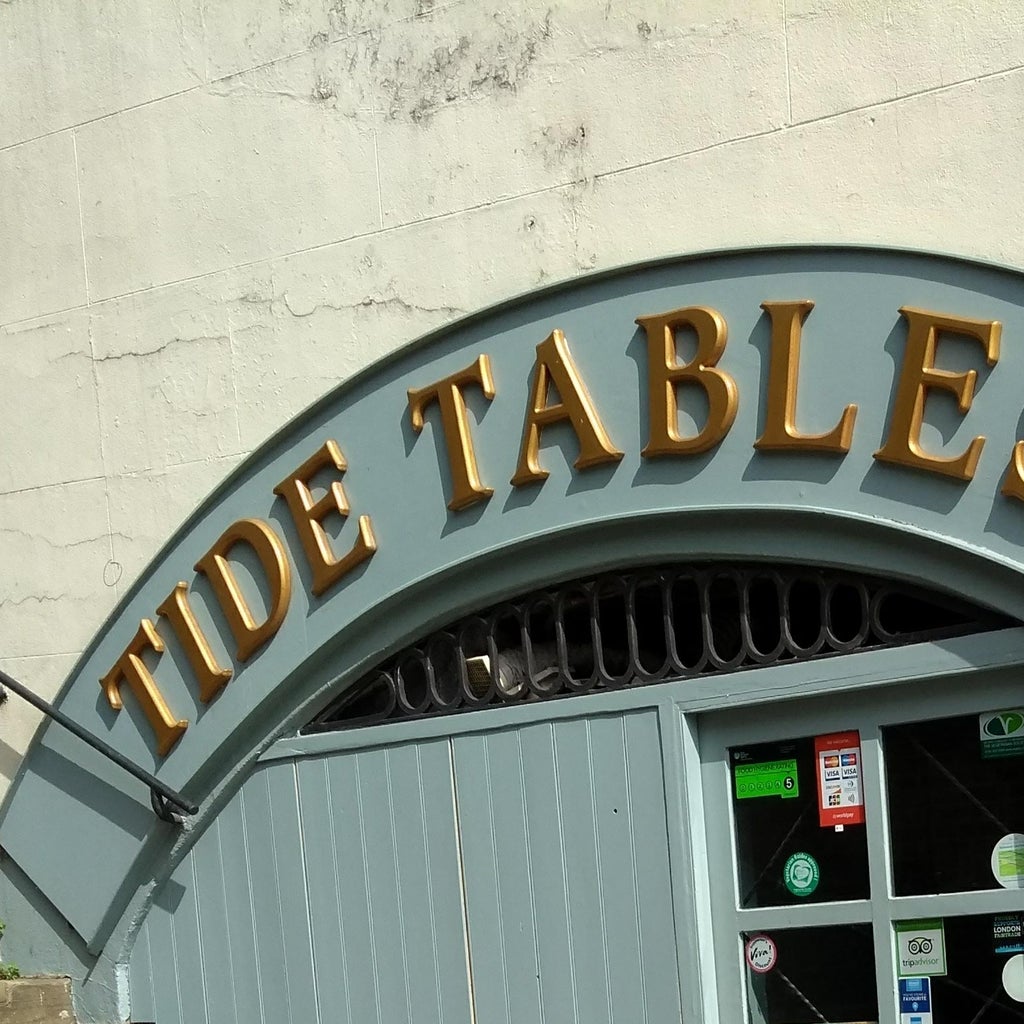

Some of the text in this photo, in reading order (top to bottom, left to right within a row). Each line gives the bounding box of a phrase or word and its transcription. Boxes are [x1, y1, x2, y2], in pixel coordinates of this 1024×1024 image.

[100, 439, 377, 757] TIDE
[785, 777, 793, 789] 5
[993, 925, 1021, 933] LONDON
[902, 956, 939, 968] tripadvisor
